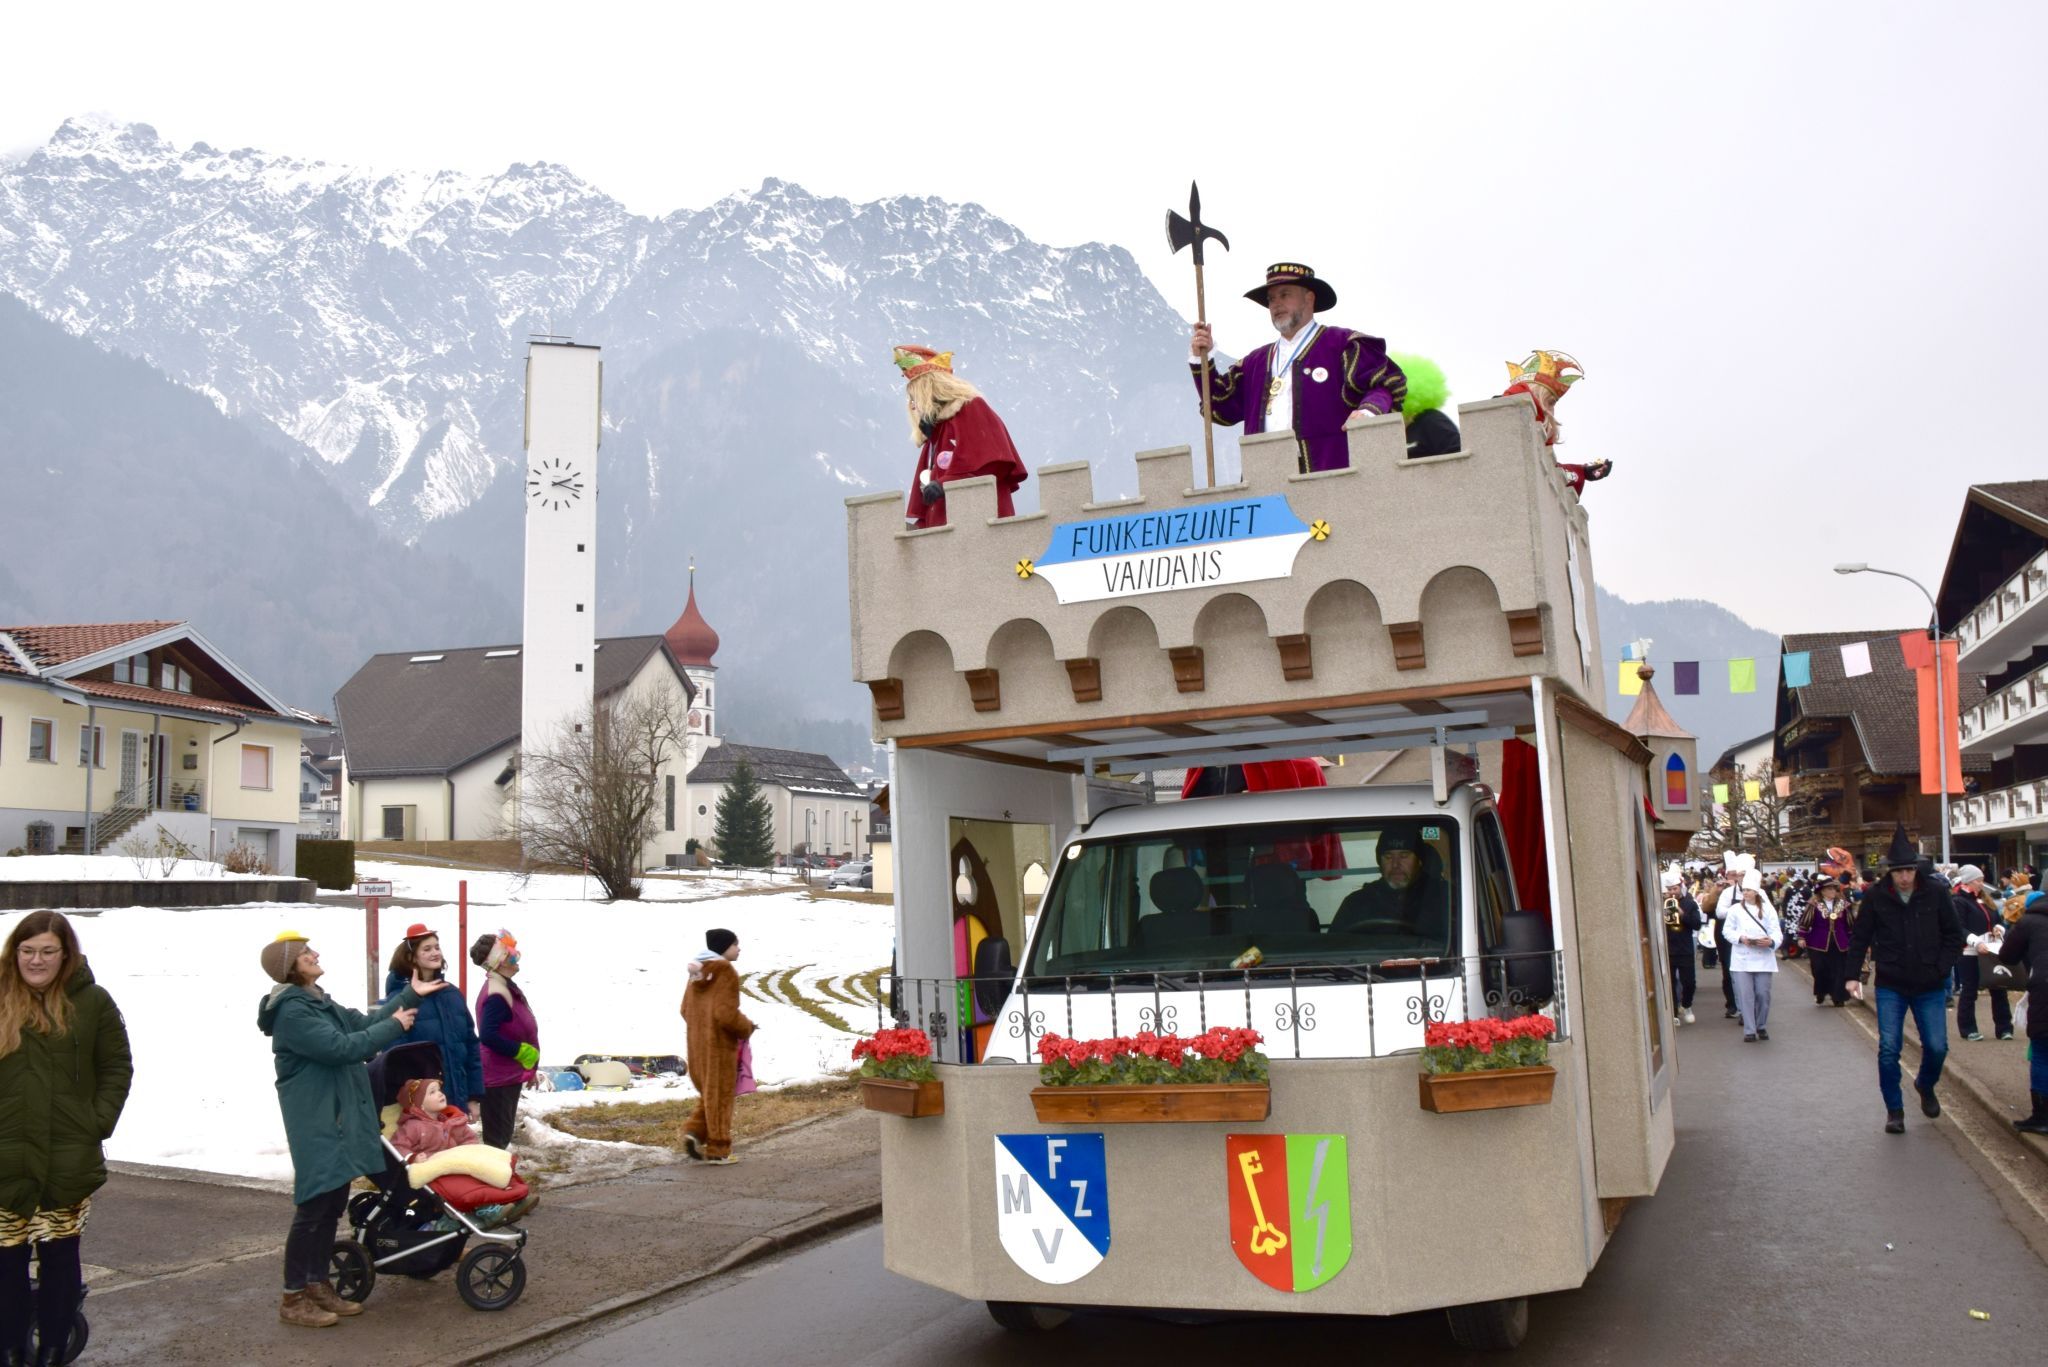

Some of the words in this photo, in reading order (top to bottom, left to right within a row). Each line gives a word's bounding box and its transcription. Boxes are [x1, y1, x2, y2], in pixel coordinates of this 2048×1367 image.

[1072, 503, 1261, 557] FUNKENZUNFT
[1103, 550, 1222, 592] VANDANS
[364, 885, 386, 895] Hydrant
[1046, 1139, 1068, 1179] F
[1001, 1173, 1032, 1214] M
[1070, 1179, 1092, 1217] Z
[1031, 1228, 1063, 1264] V
